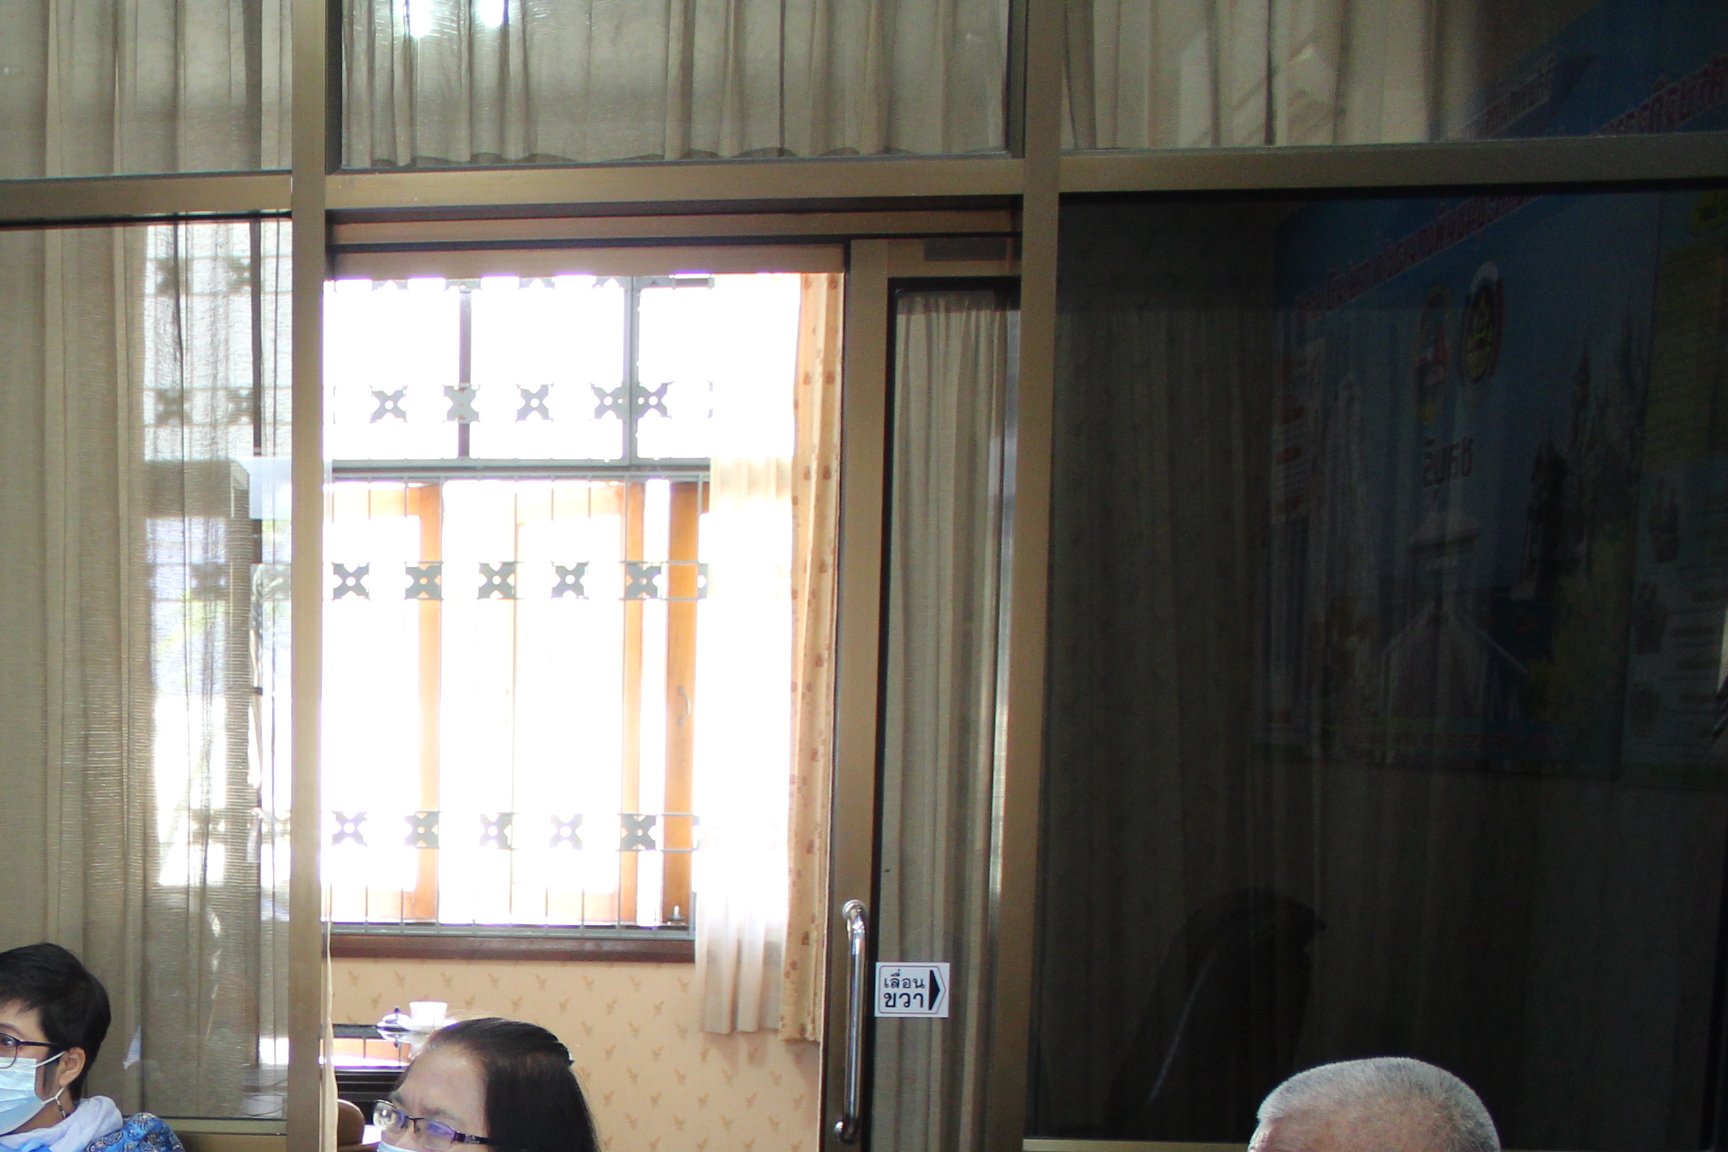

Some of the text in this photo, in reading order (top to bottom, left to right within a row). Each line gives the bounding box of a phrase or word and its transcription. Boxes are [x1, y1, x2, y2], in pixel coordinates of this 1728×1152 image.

[883, 968, 926, 989] เลื่อน
[883, 992, 925, 1008] ขวา
